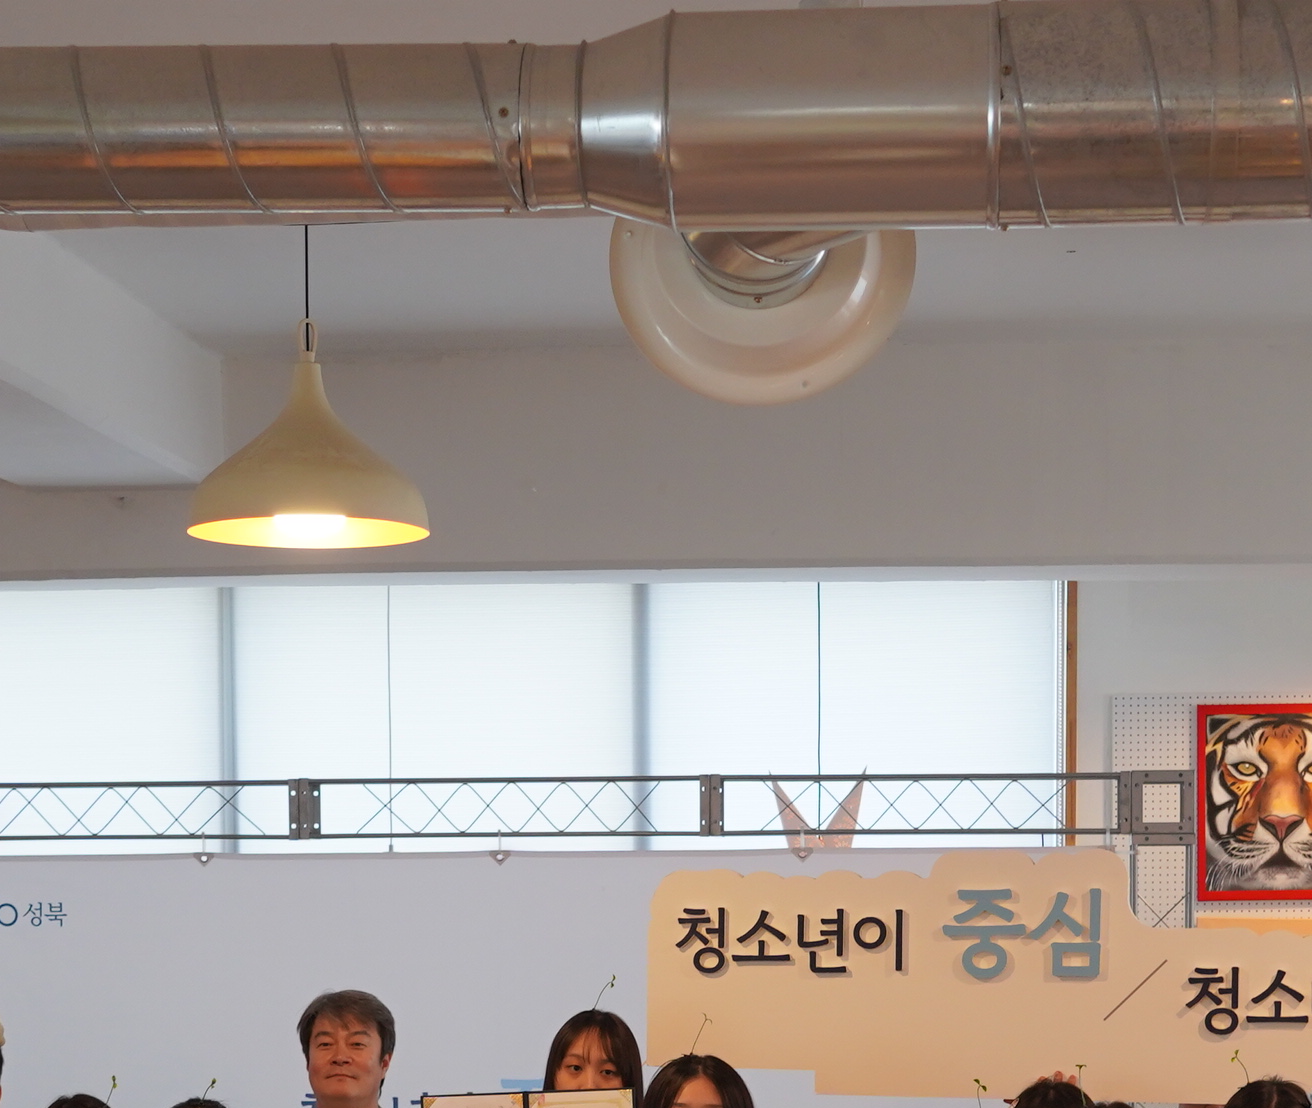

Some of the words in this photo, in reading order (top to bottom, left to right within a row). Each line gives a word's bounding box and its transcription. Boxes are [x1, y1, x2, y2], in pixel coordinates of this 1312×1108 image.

[23, 902, 67, 927] 성북
[675, 907, 904, 974] 청소년이
[942, 888, 1102, 979] 중심
